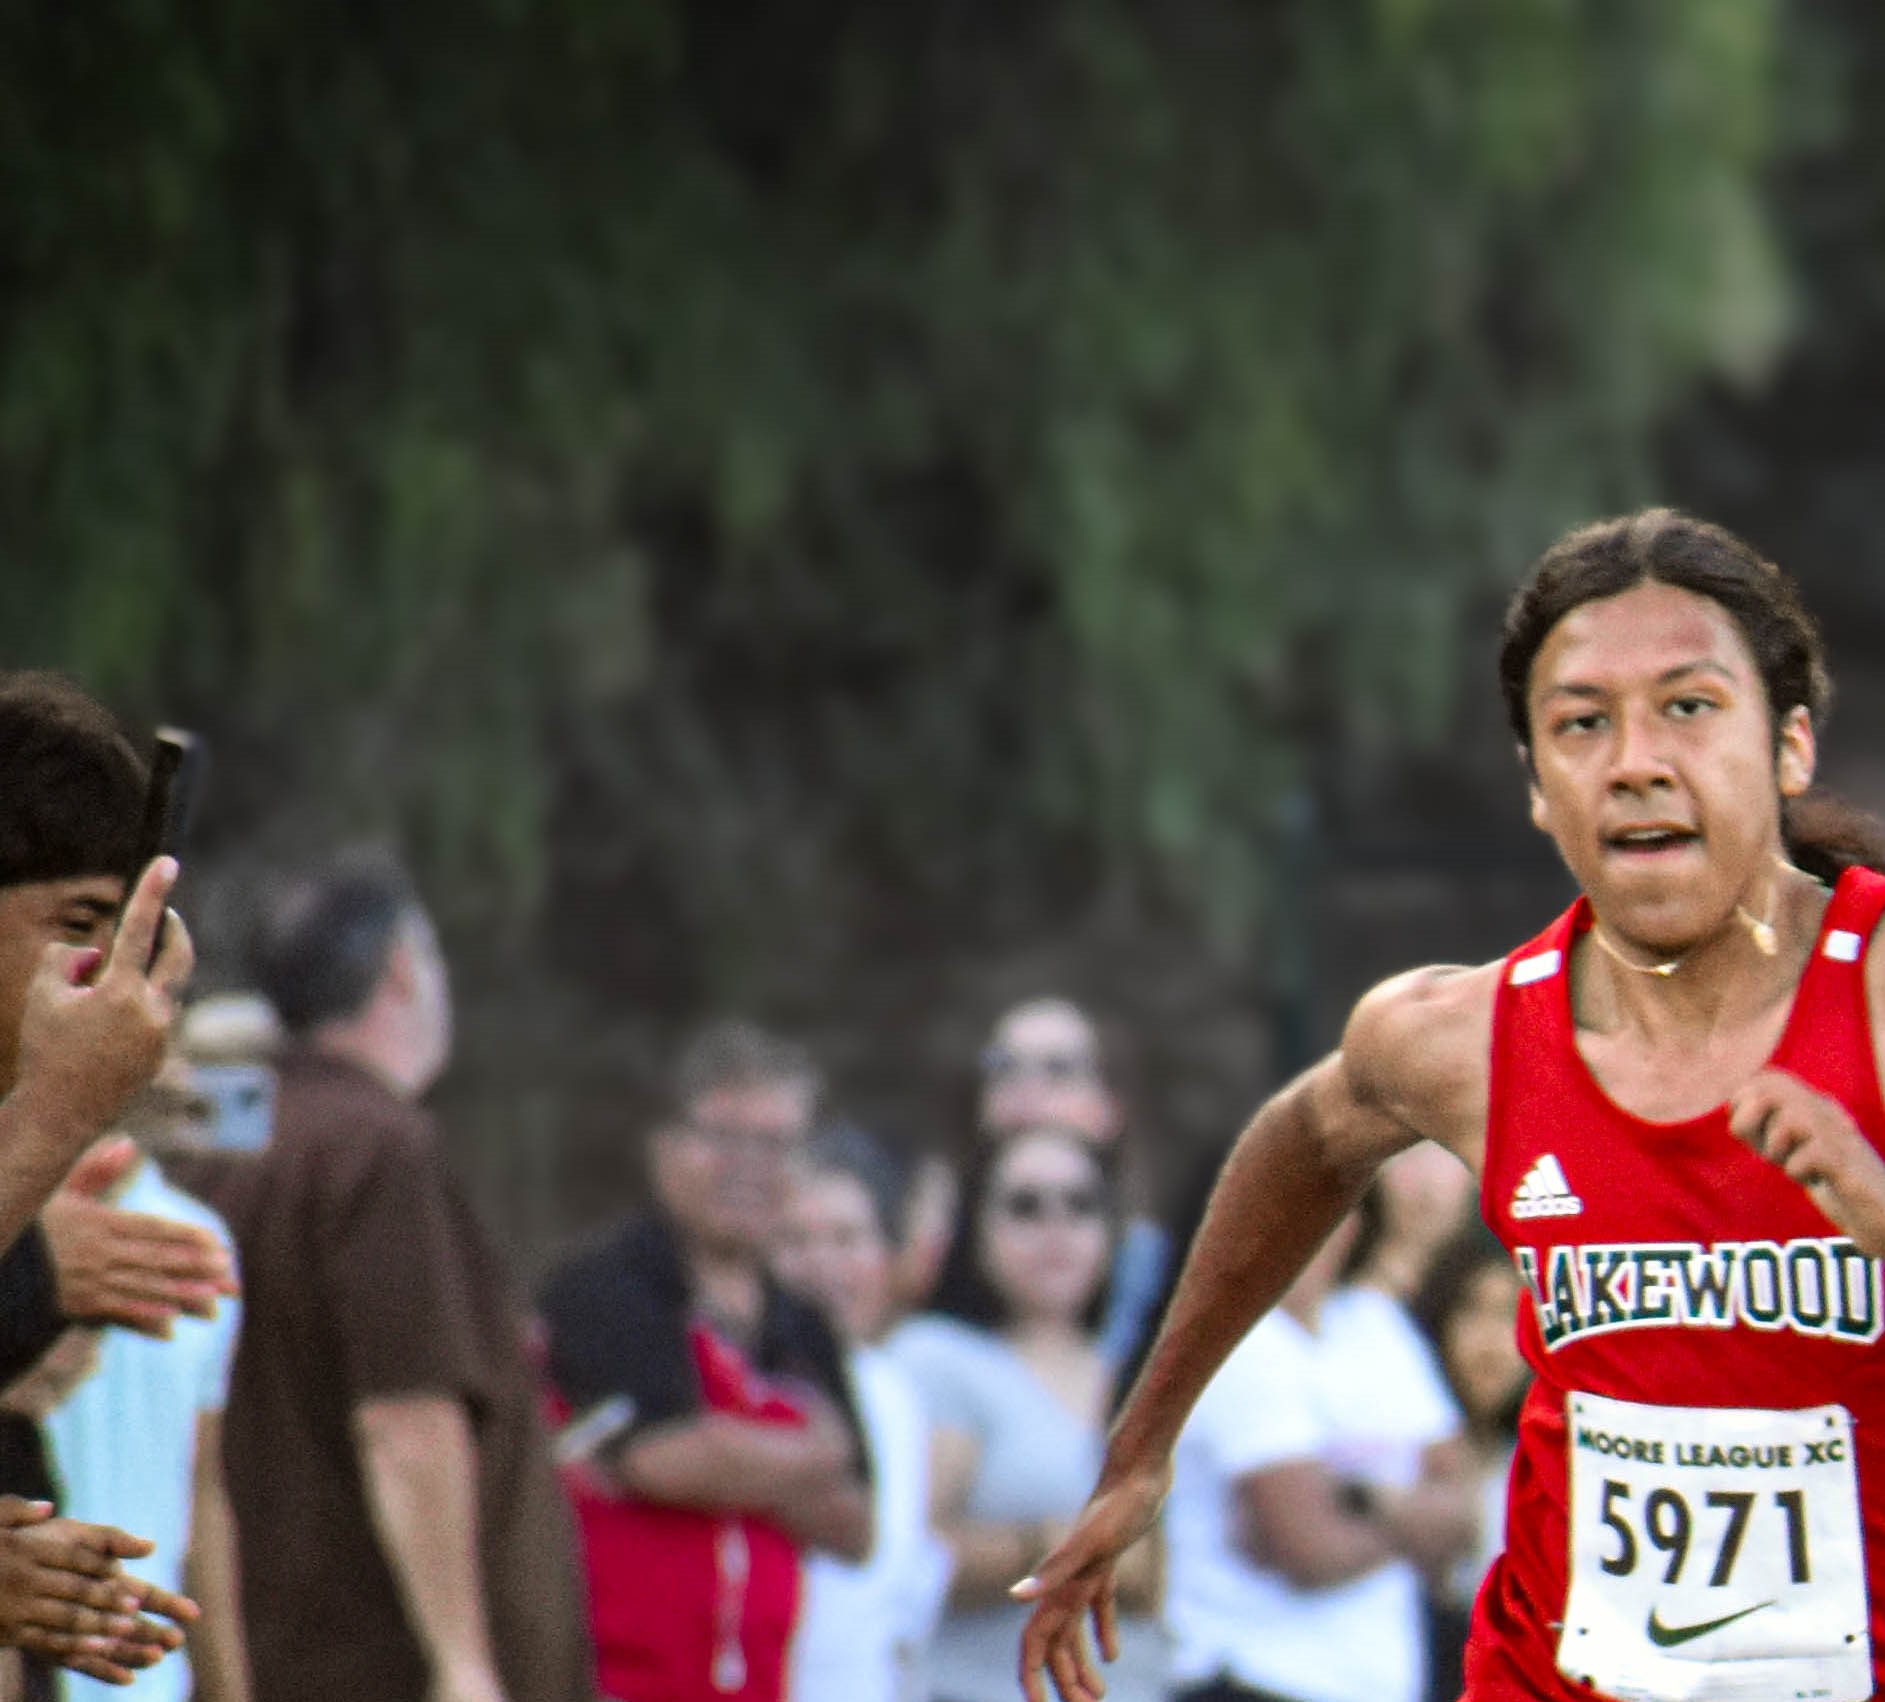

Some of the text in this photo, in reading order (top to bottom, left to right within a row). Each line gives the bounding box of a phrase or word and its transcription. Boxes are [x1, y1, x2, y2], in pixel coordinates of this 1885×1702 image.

[1578, 1426, 1846, 1468] MOORE LEAGUE XC
[1600, 1478, 1811, 1587] 5971
